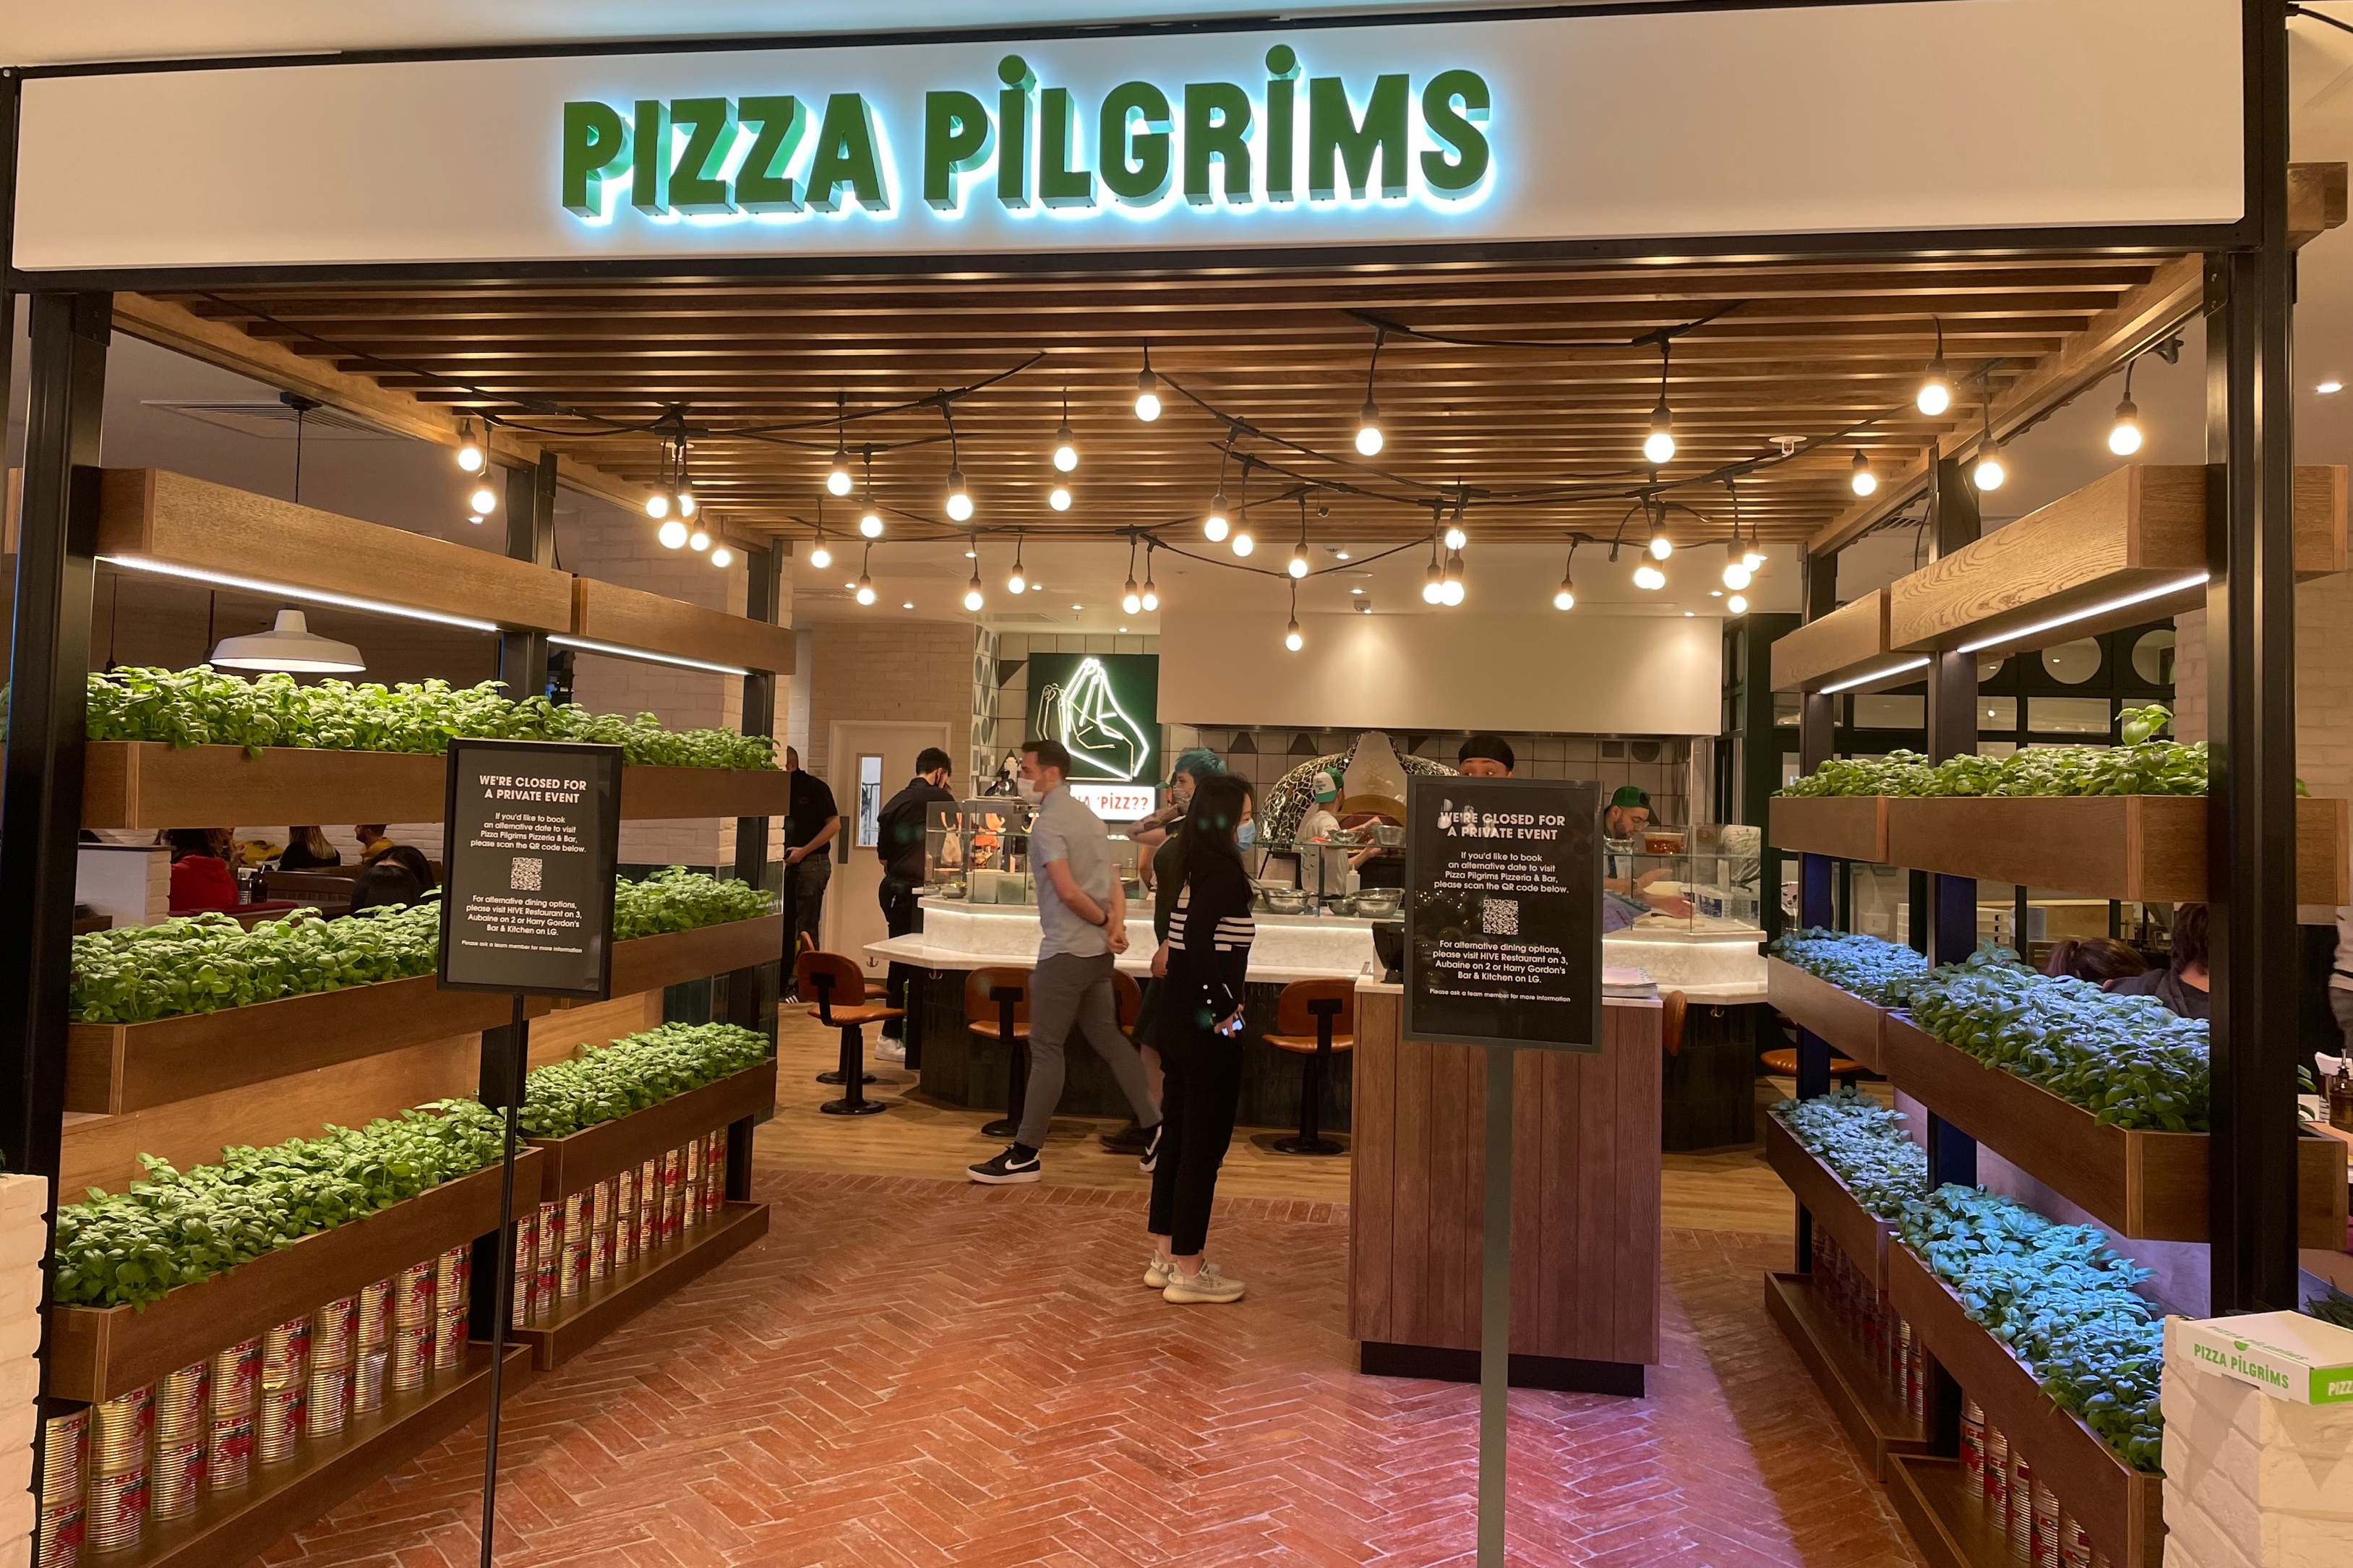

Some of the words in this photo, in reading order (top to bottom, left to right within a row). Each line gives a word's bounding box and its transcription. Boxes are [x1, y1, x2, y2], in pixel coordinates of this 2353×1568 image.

[563, 92, 888, 214] PIZZA
[479, 775, 512, 787] WE'RE
[515, 776, 560, 789] CLOSED
[563, 779, 587, 791] FOR
[484, 789, 493, 798] A
[496, 789, 541, 801] PRIVATE
[544, 792, 580, 803] EVENT
[546, 815, 565, 823] book
[1439, 812, 1478, 823] WE'RE
[1482, 813, 1535, 825] CLOSED
[1538, 815, 1565, 826] FOR
[494, 822, 533, 831] alternative
[1446, 826, 1457, 836] A
[1461, 827, 1513, 839] PRIVATE
[1517, 828, 1558, 840] EVENT
[500, 831, 527, 841] Pilgrims
[528, 833, 555, 841] Pizzeria
[563, 835, 578, 844] Bar,
[470, 839, 495, 847] please
[562, 844, 586, 852] below.
[1467, 852, 1491, 861] you'd
[1493, 852, 1508, 861] like
[1520, 853, 1543, 862] book
[1460, 861, 1506, 870] alternative
[1539, 864, 1556, 873] visit
[1445, 870, 1466, 879] Pizza
[1467, 871, 1499, 881] Pilgrims
[1500, 873, 1532, 881] Pizzeria
[1542, 874, 1559, 883] Bar,
[1433, 880, 1462, 889] please
[1516, 883, 1539, 892] code
[1540, 884, 1569, 894] below.
[484, 896, 523, 905] alternative
[524, 898, 548, 909] dining
[548, 900, 577, 909] options,
[466, 904, 491, 912] please
[525, 907, 564, 917] Restaurant
[575, 911, 582, 920] 3,
[467, 913, 499, 922] Aubaine
[526, 917, 546, 927] Harry
[547, 918, 580, 927] Gordon's
[507, 925, 534, 934] Kitchen
[1454, 941, 1499, 951] alternative
[1500, 943, 1527, 954] dining
[1527, 945, 1561, 955] options,
[1433, 950, 1461, 959] please
[1462, 951, 1479, 959] visit
[1480, 951, 1499, 961] HIVE
[1501, 953, 1546, 963] Restaurant
[1560, 956, 1569, 965] 3,
[1435, 959, 1471, 969] Aubaine
[1503, 963, 1525, 974] Harry
[1527, 964, 1566, 974] Gordon's
[1481, 972, 1513, 982] Kitchen
[1527, 974, 1542, 983] LG.
[2194, 1343, 2227, 1367] PIZZA
